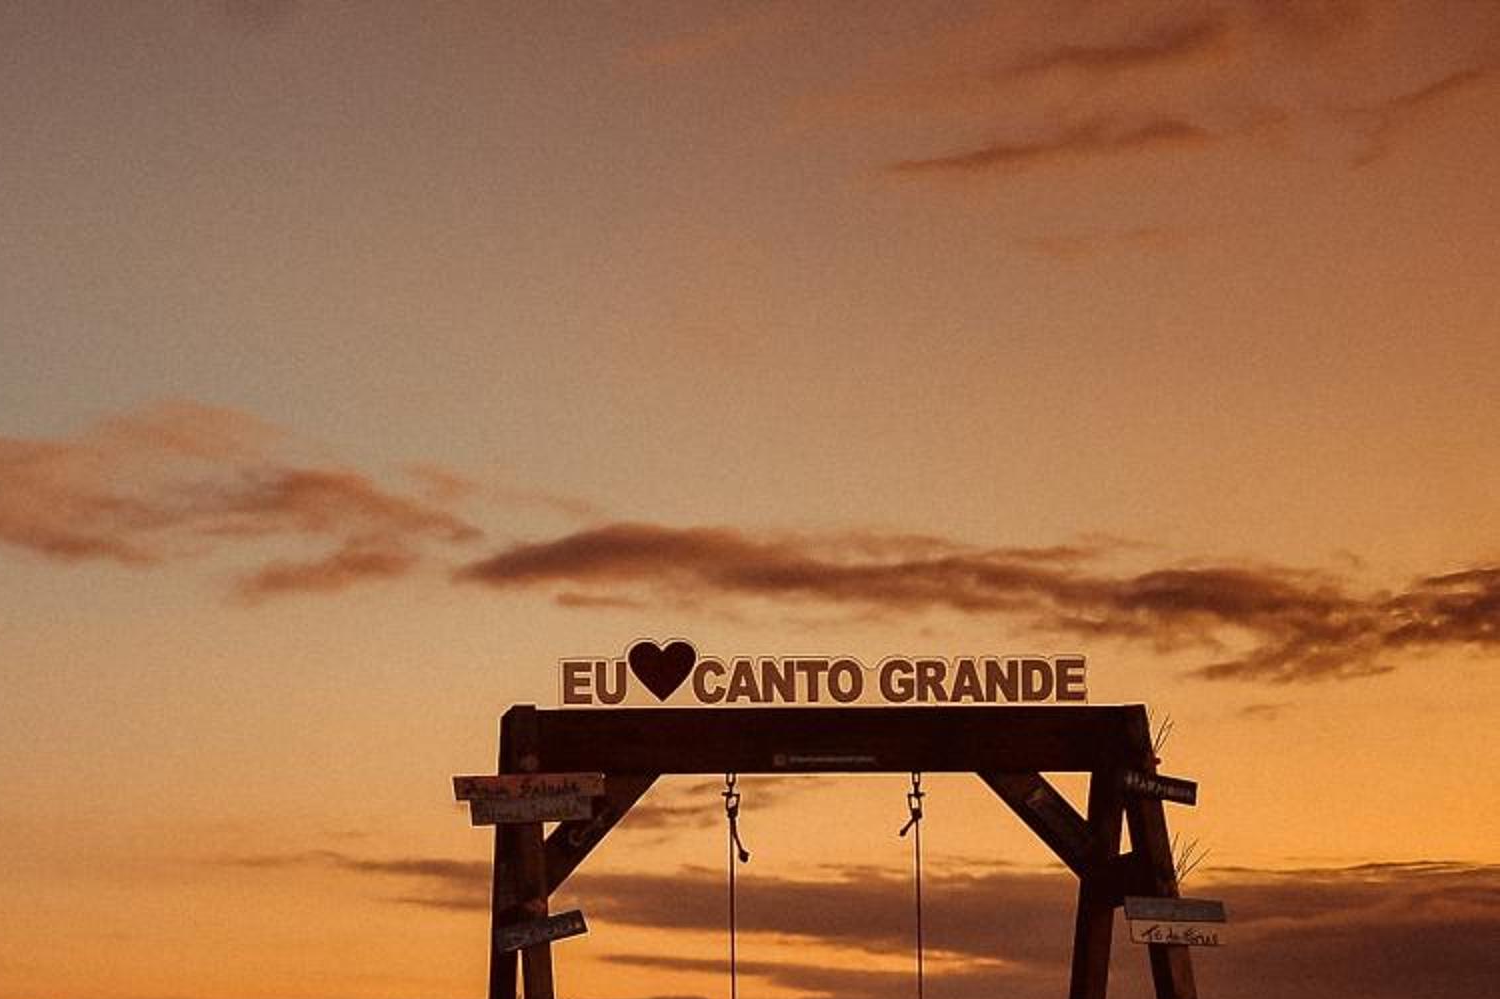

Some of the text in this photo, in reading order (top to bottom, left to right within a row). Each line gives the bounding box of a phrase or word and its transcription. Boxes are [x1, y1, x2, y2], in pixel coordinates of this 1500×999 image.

[563, 659, 1085, 704] EU CANTO GRANDE
